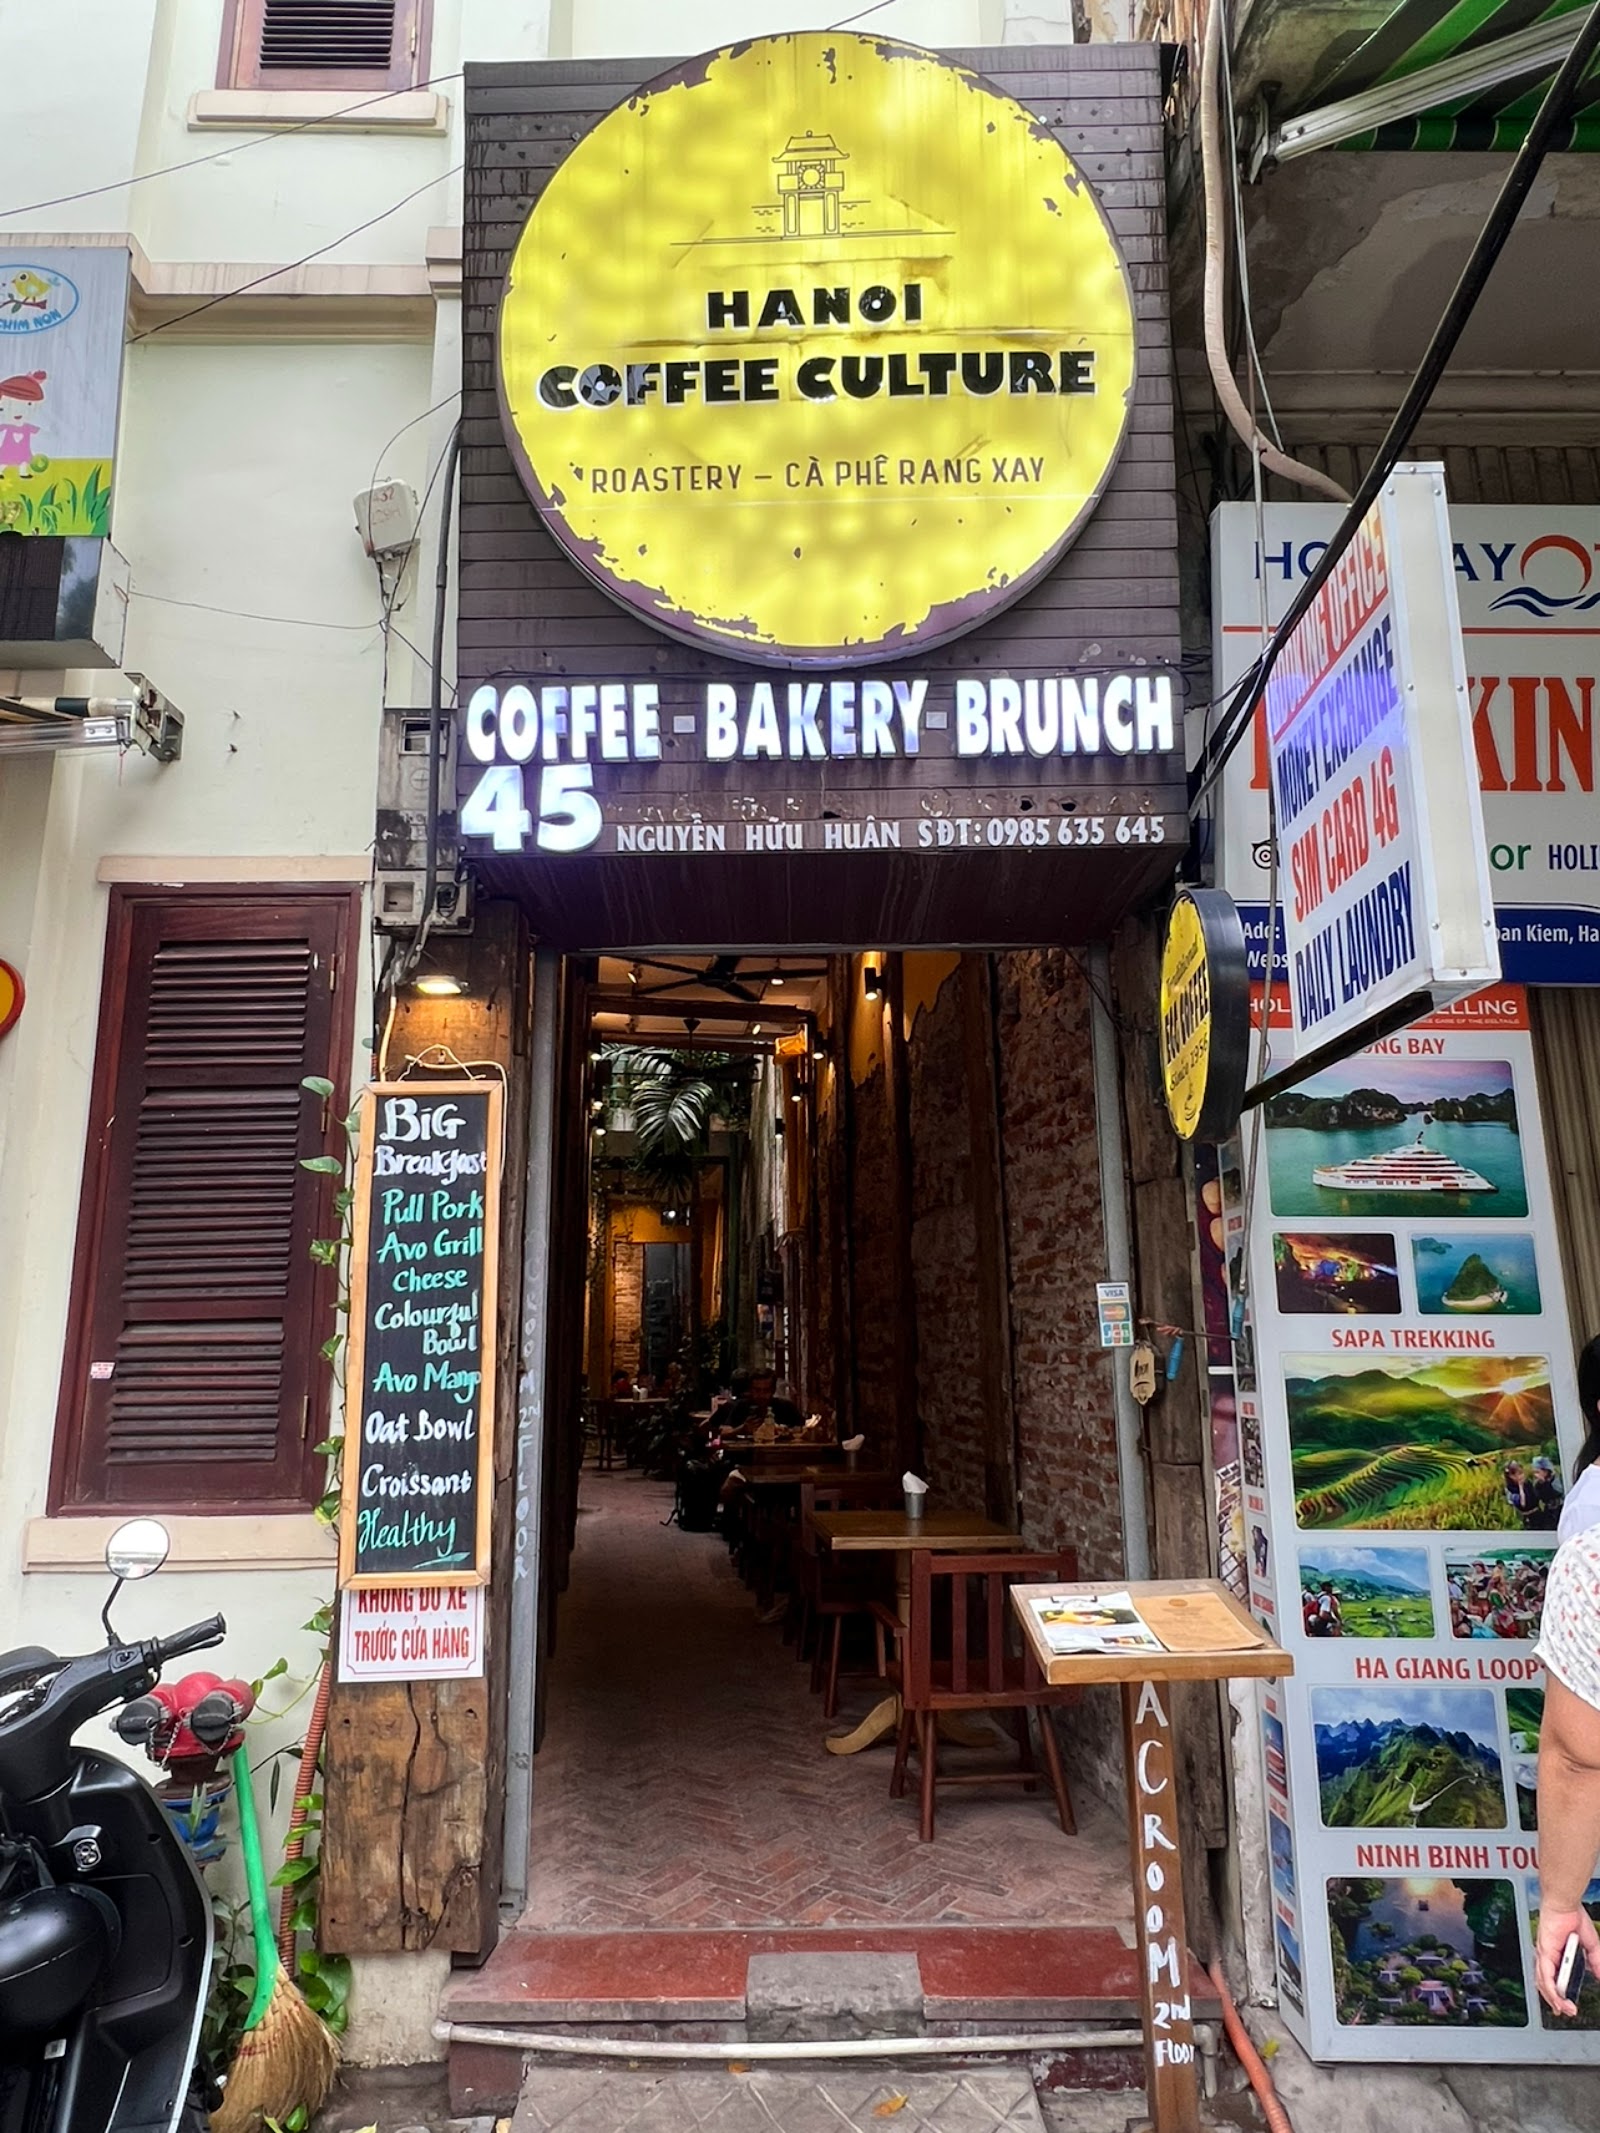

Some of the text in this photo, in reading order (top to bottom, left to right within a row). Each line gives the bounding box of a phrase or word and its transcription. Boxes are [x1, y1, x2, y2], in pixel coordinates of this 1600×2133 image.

[706, 284, 923, 330] HANOI
[538, 349, 1097, 410] COFFEE CULTURE
[591, 463, 742, 494] ROASTERY
[786, 455, 825, 488] CÀ
[835, 454, 888, 487] PHÊ
[899, 457, 982, 484] RANG
[992, 456, 1045, 483] XAY
[1328, 500, 1386, 653] OFFICE
[465, 683, 662, 764] COFFEE
[705, 680, 930, 762] BAKERY
[955, 675, 1175, 757] BRUNCH
[1277, 614, 1398, 830] MONEY EXCHANGE
[460, 763, 604, 852] 45
[824, 814, 900, 850] HUÂN
[1057, 816, 1105, 846] 635
[1114, 815, 1165, 844] 645
[1290, 745, 1400, 922] SIM CARD 4G
[1295, 860, 1416, 1032] DAILY LAUNDRY
[1526, 923, 1574, 945] Kiem,
[1437, 1000, 1518, 1015] LLING
[1407, 1038, 1446, 1055] BAY
[381, 1188, 484, 1226] Pull Pork
[376, 1226, 484, 1263] Avo Grill
[1103, 1289, 1125, 1299] VISA
[422, 1324, 478, 1356] Bowl
[1331, 1328, 1495, 1348] SAPA TREKKING
[373, 1362, 418, 1393] Avo
[365, 1408, 476, 1445] Oat Bowl
[362, 1463, 473, 1498] Croissant
[357, 1507, 456, 1558] Healthy
[446, 1586, 468, 1610] XE
[354, 1614, 470, 1662] TRƯỚC CỬA HÀNG
[1355, 1657, 1538, 1680] HA GIANG LOOP
[1357, 1844, 1419, 1867] NINH
[1428, 1845, 1489, 1868] BINH
